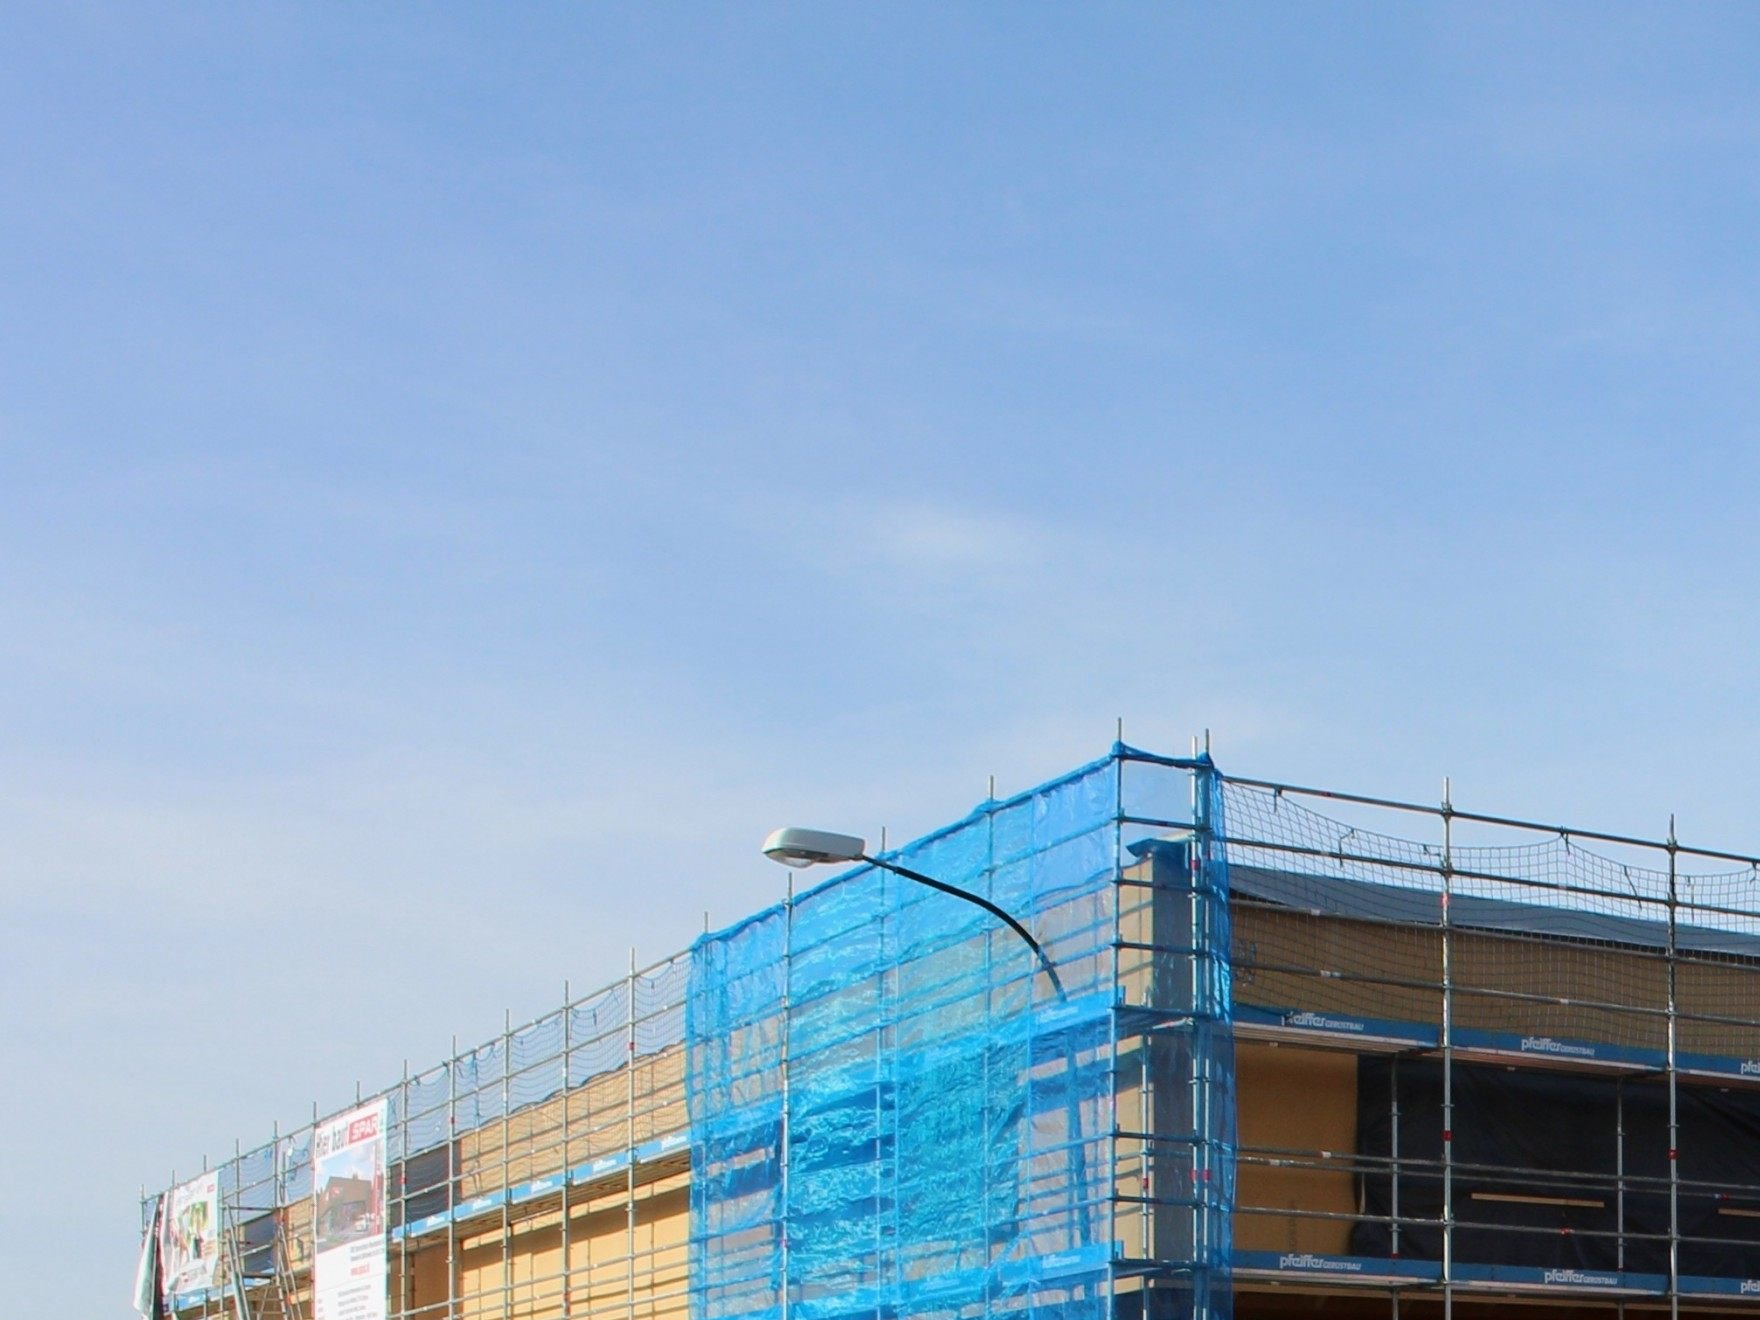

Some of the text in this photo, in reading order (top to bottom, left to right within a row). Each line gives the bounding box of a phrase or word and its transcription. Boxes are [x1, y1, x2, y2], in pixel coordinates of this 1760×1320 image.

[350, 1115, 378, 1142] SPAR
[1280, 1254, 1324, 1269] pfeiffer
[1544, 1269, 1584, 1283] pfeiffer
